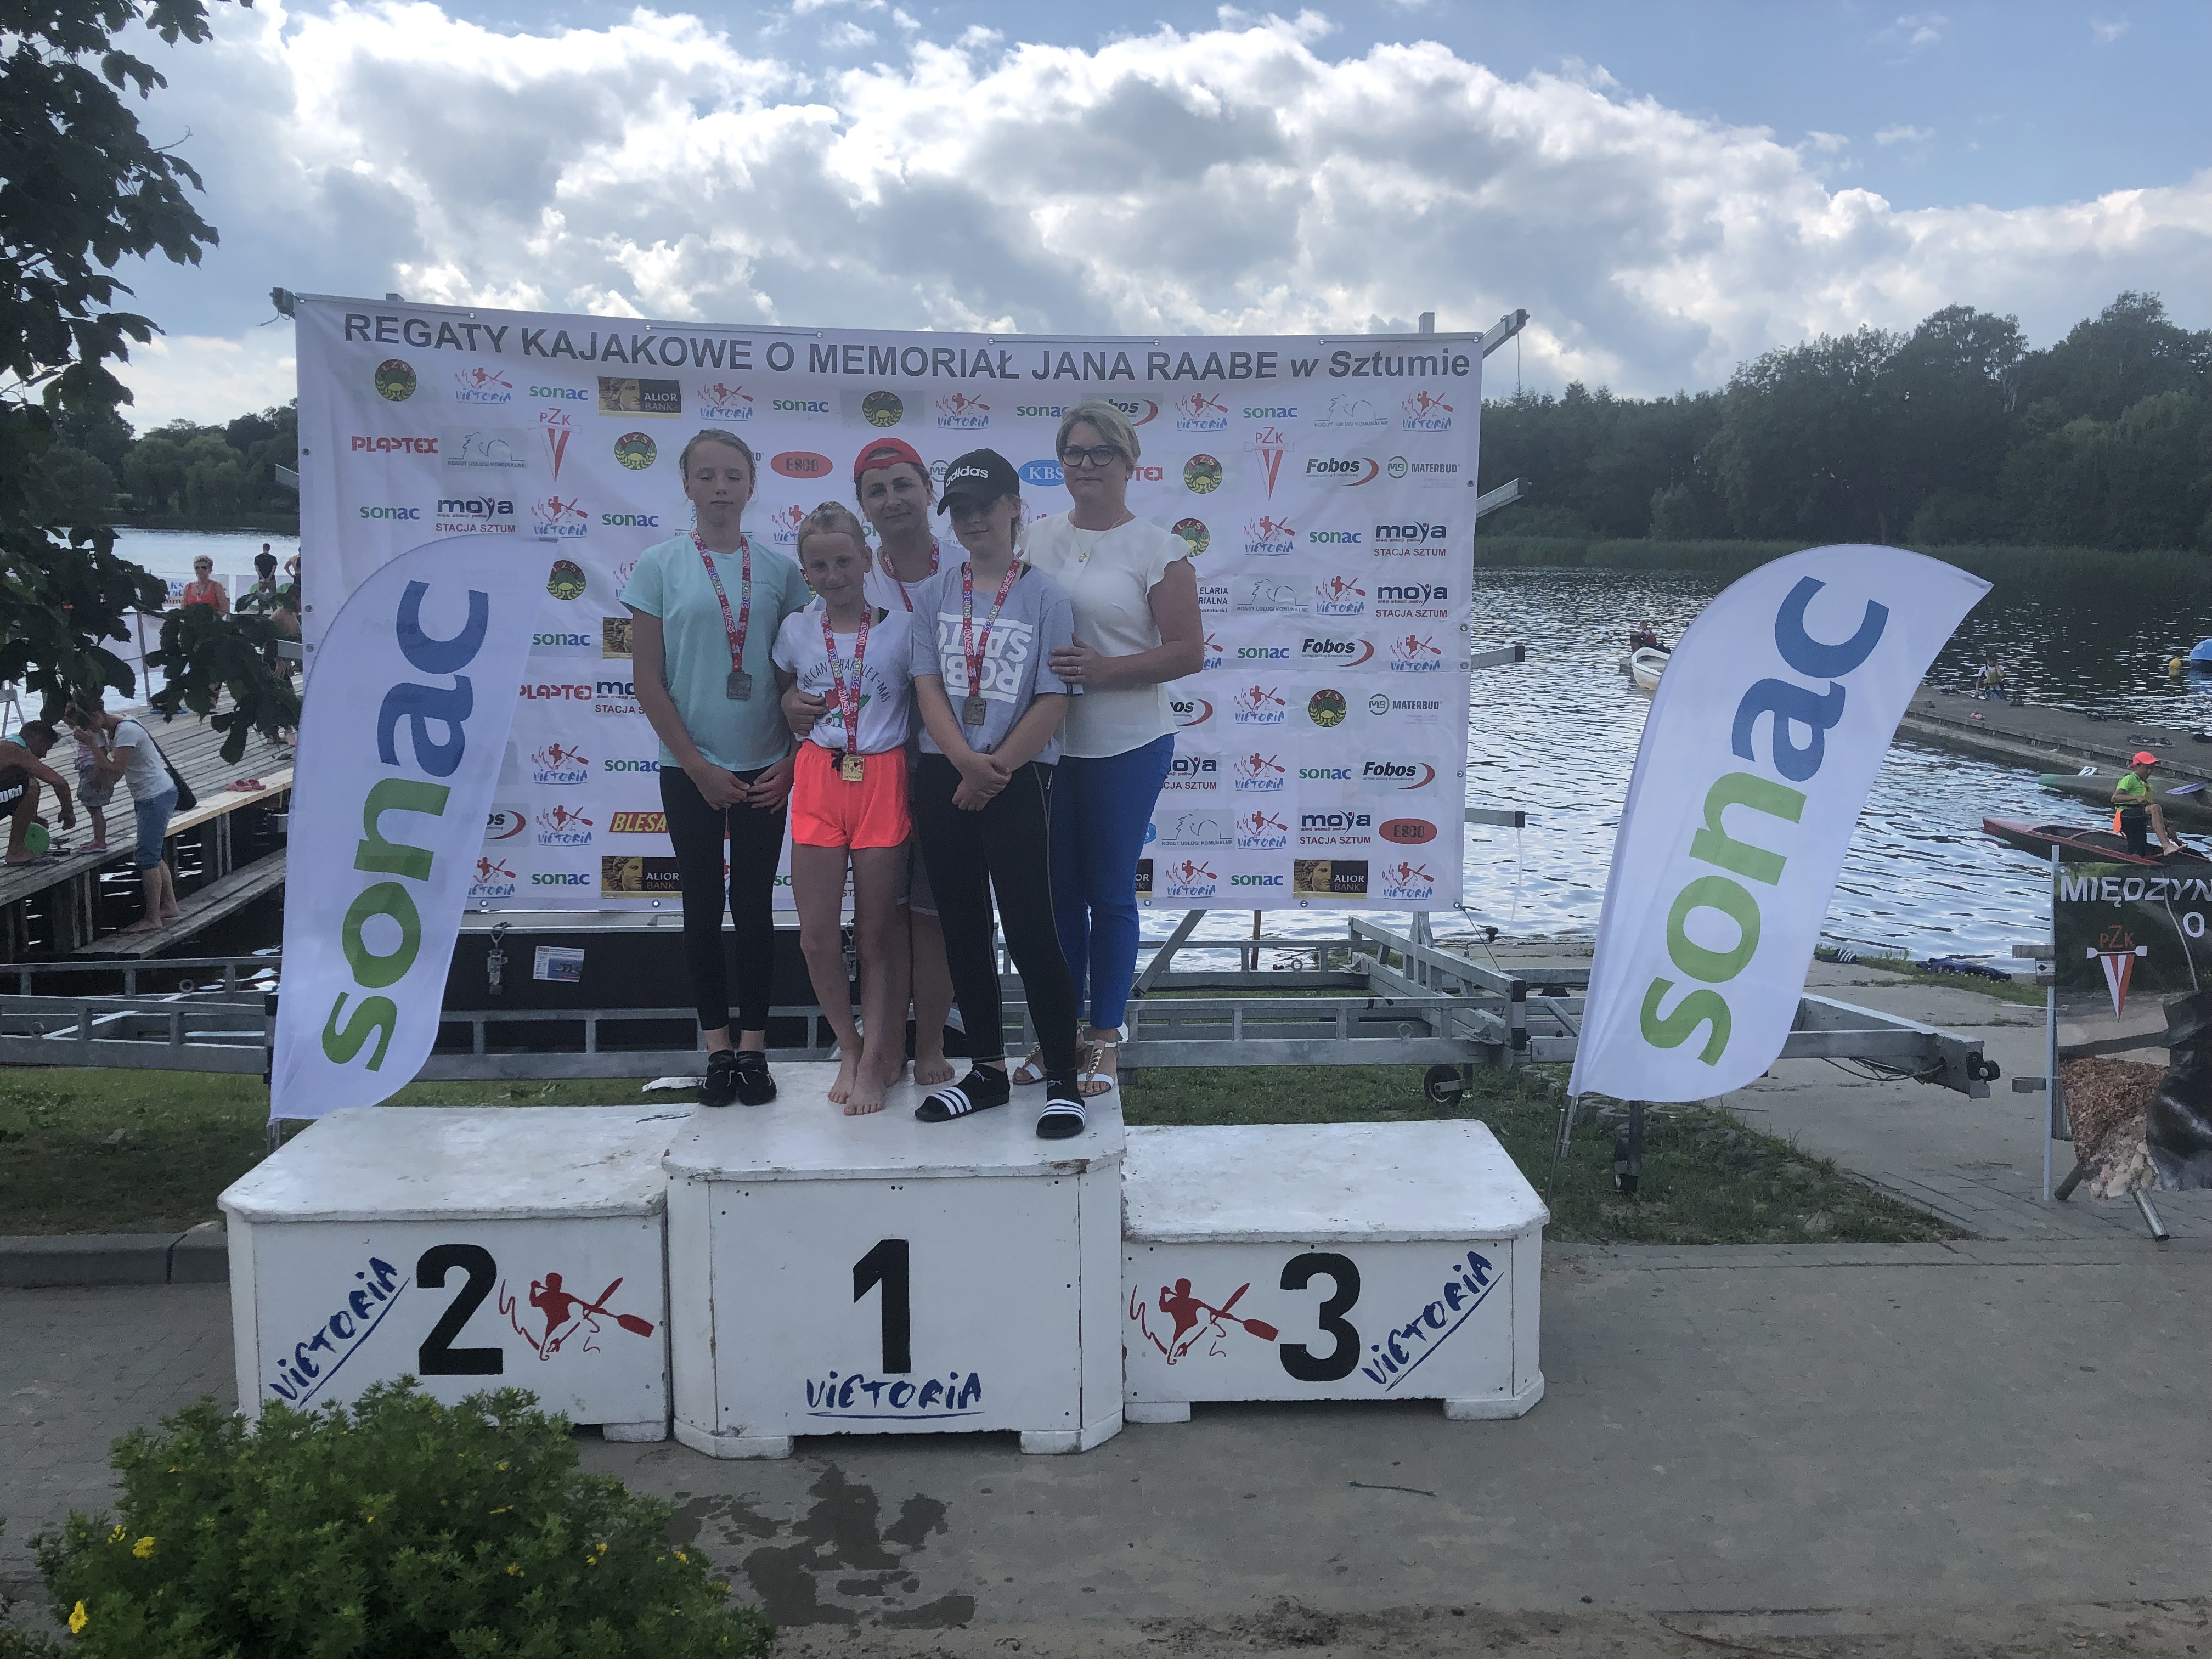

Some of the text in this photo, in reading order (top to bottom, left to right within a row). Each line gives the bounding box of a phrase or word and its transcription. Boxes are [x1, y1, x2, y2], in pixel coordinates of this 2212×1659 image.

[344, 313, 1470, 381] REGATY KAJAKOWE O MEMORIAŁ JANA RAABE w Sztumie
[529, 386, 588, 400] sonac
[644, 393, 678, 402] ALIOR
[645, 403, 673, 411] BANK
[772, 399, 830, 413] sonac
[1243, 407, 1298, 418] sonac
[540, 408, 571, 426] PZK
[1255, 426, 1284, 444] PZK
[352, 436, 438, 454] PLASTEX
[1306, 458, 1361, 473] Fobos
[946, 465, 989, 487] adidas
[1029, 467, 1064, 480] KBS
[360, 506, 420, 520] sonac
[437, 495, 514, 522] moya
[436, 523, 516, 533] STACJA SZTUM
[602, 514, 659, 527] sonac
[1309, 532, 1362, 544] sonac
[1376, 521, 1446, 545] moya
[707, 566, 725, 596] sonac
[741, 580, 751, 609] sonac
[1378, 582, 1448, 607] moya
[963, 590, 972, 618] sonac
[983, 605, 1000, 633] sonac
[1415, 609, 1447, 617] SZTUM
[532, 633, 590, 646] sonac
[1302, 639, 1355, 653] Fobos
[1238, 647, 1289, 659] sonac
[809, 662, 828, 679] CAN
[828, 648, 842, 679] sonac
[852, 657, 862, 689] sonac
[597, 681, 635, 695] mo
[595, 704, 636, 714] STACJA
[605, 760, 661, 772] sonac
[1171, 755, 1217, 780] oya
[1363, 761, 1417, 776] Fobos
[1299, 768, 1352, 780] sonac
[321, 579, 489, 1073] sonac
[1301, 810, 1371, 834] moya
[1639, 575, 1889, 1067] sonac
[531, 873, 590, 885] sonac
[647, 882, 675, 890] BANK
[1231, 874, 1283, 886] sonac
[1334, 874, 1365, 883] ALIOR
[2099, 924, 2135, 948] PZK
[416, 1243, 503, 1376] 2
[853, 1239, 911, 1374] 1
[1279, 1252, 1361, 1382] 3
